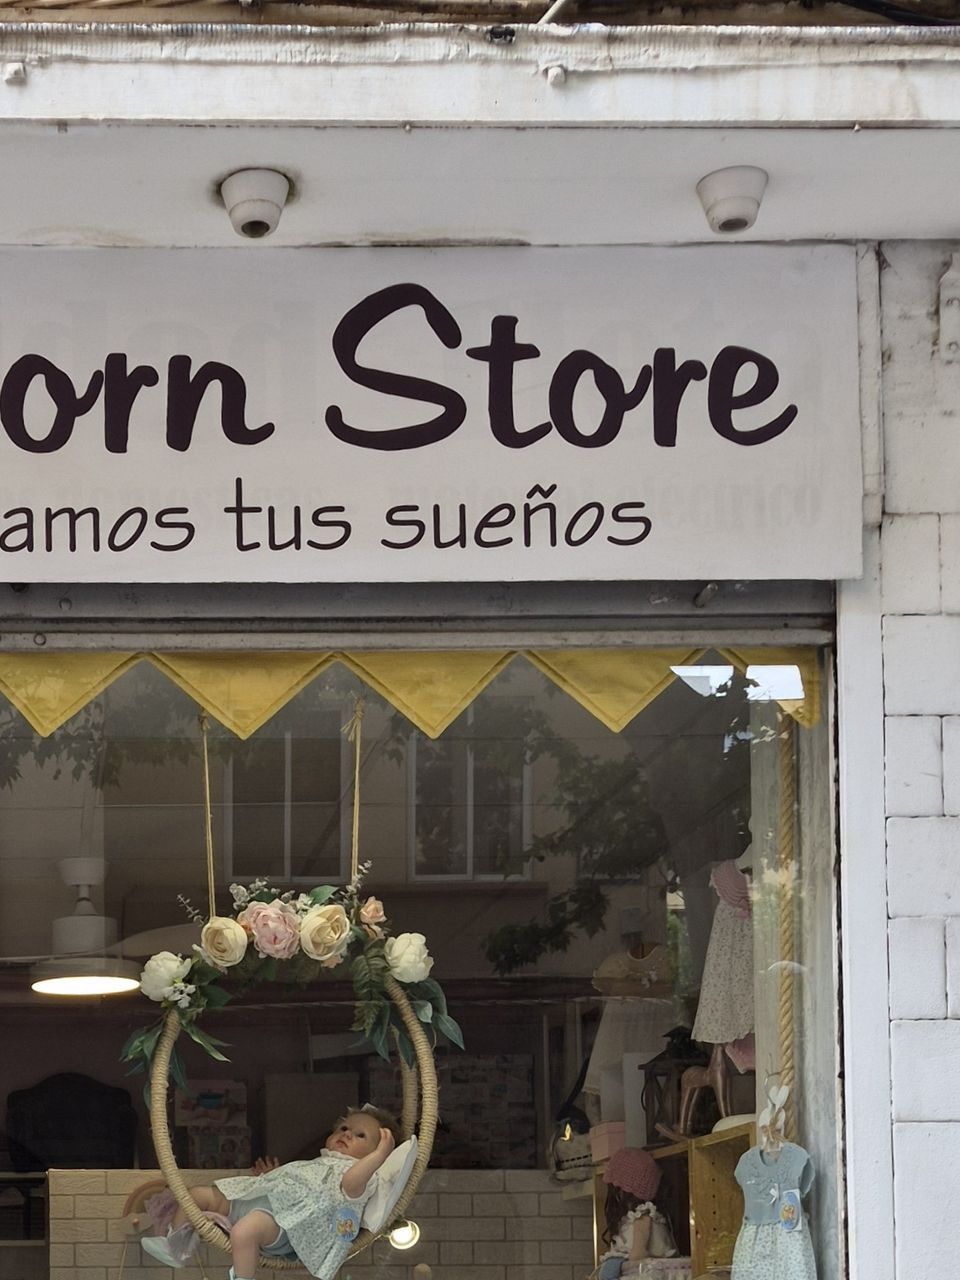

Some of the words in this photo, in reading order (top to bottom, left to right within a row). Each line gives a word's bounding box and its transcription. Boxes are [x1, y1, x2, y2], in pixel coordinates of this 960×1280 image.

[324, 282, 799, 452] Store
[223, 477, 352, 552] tus
[380, 484, 652, 552] sueños
